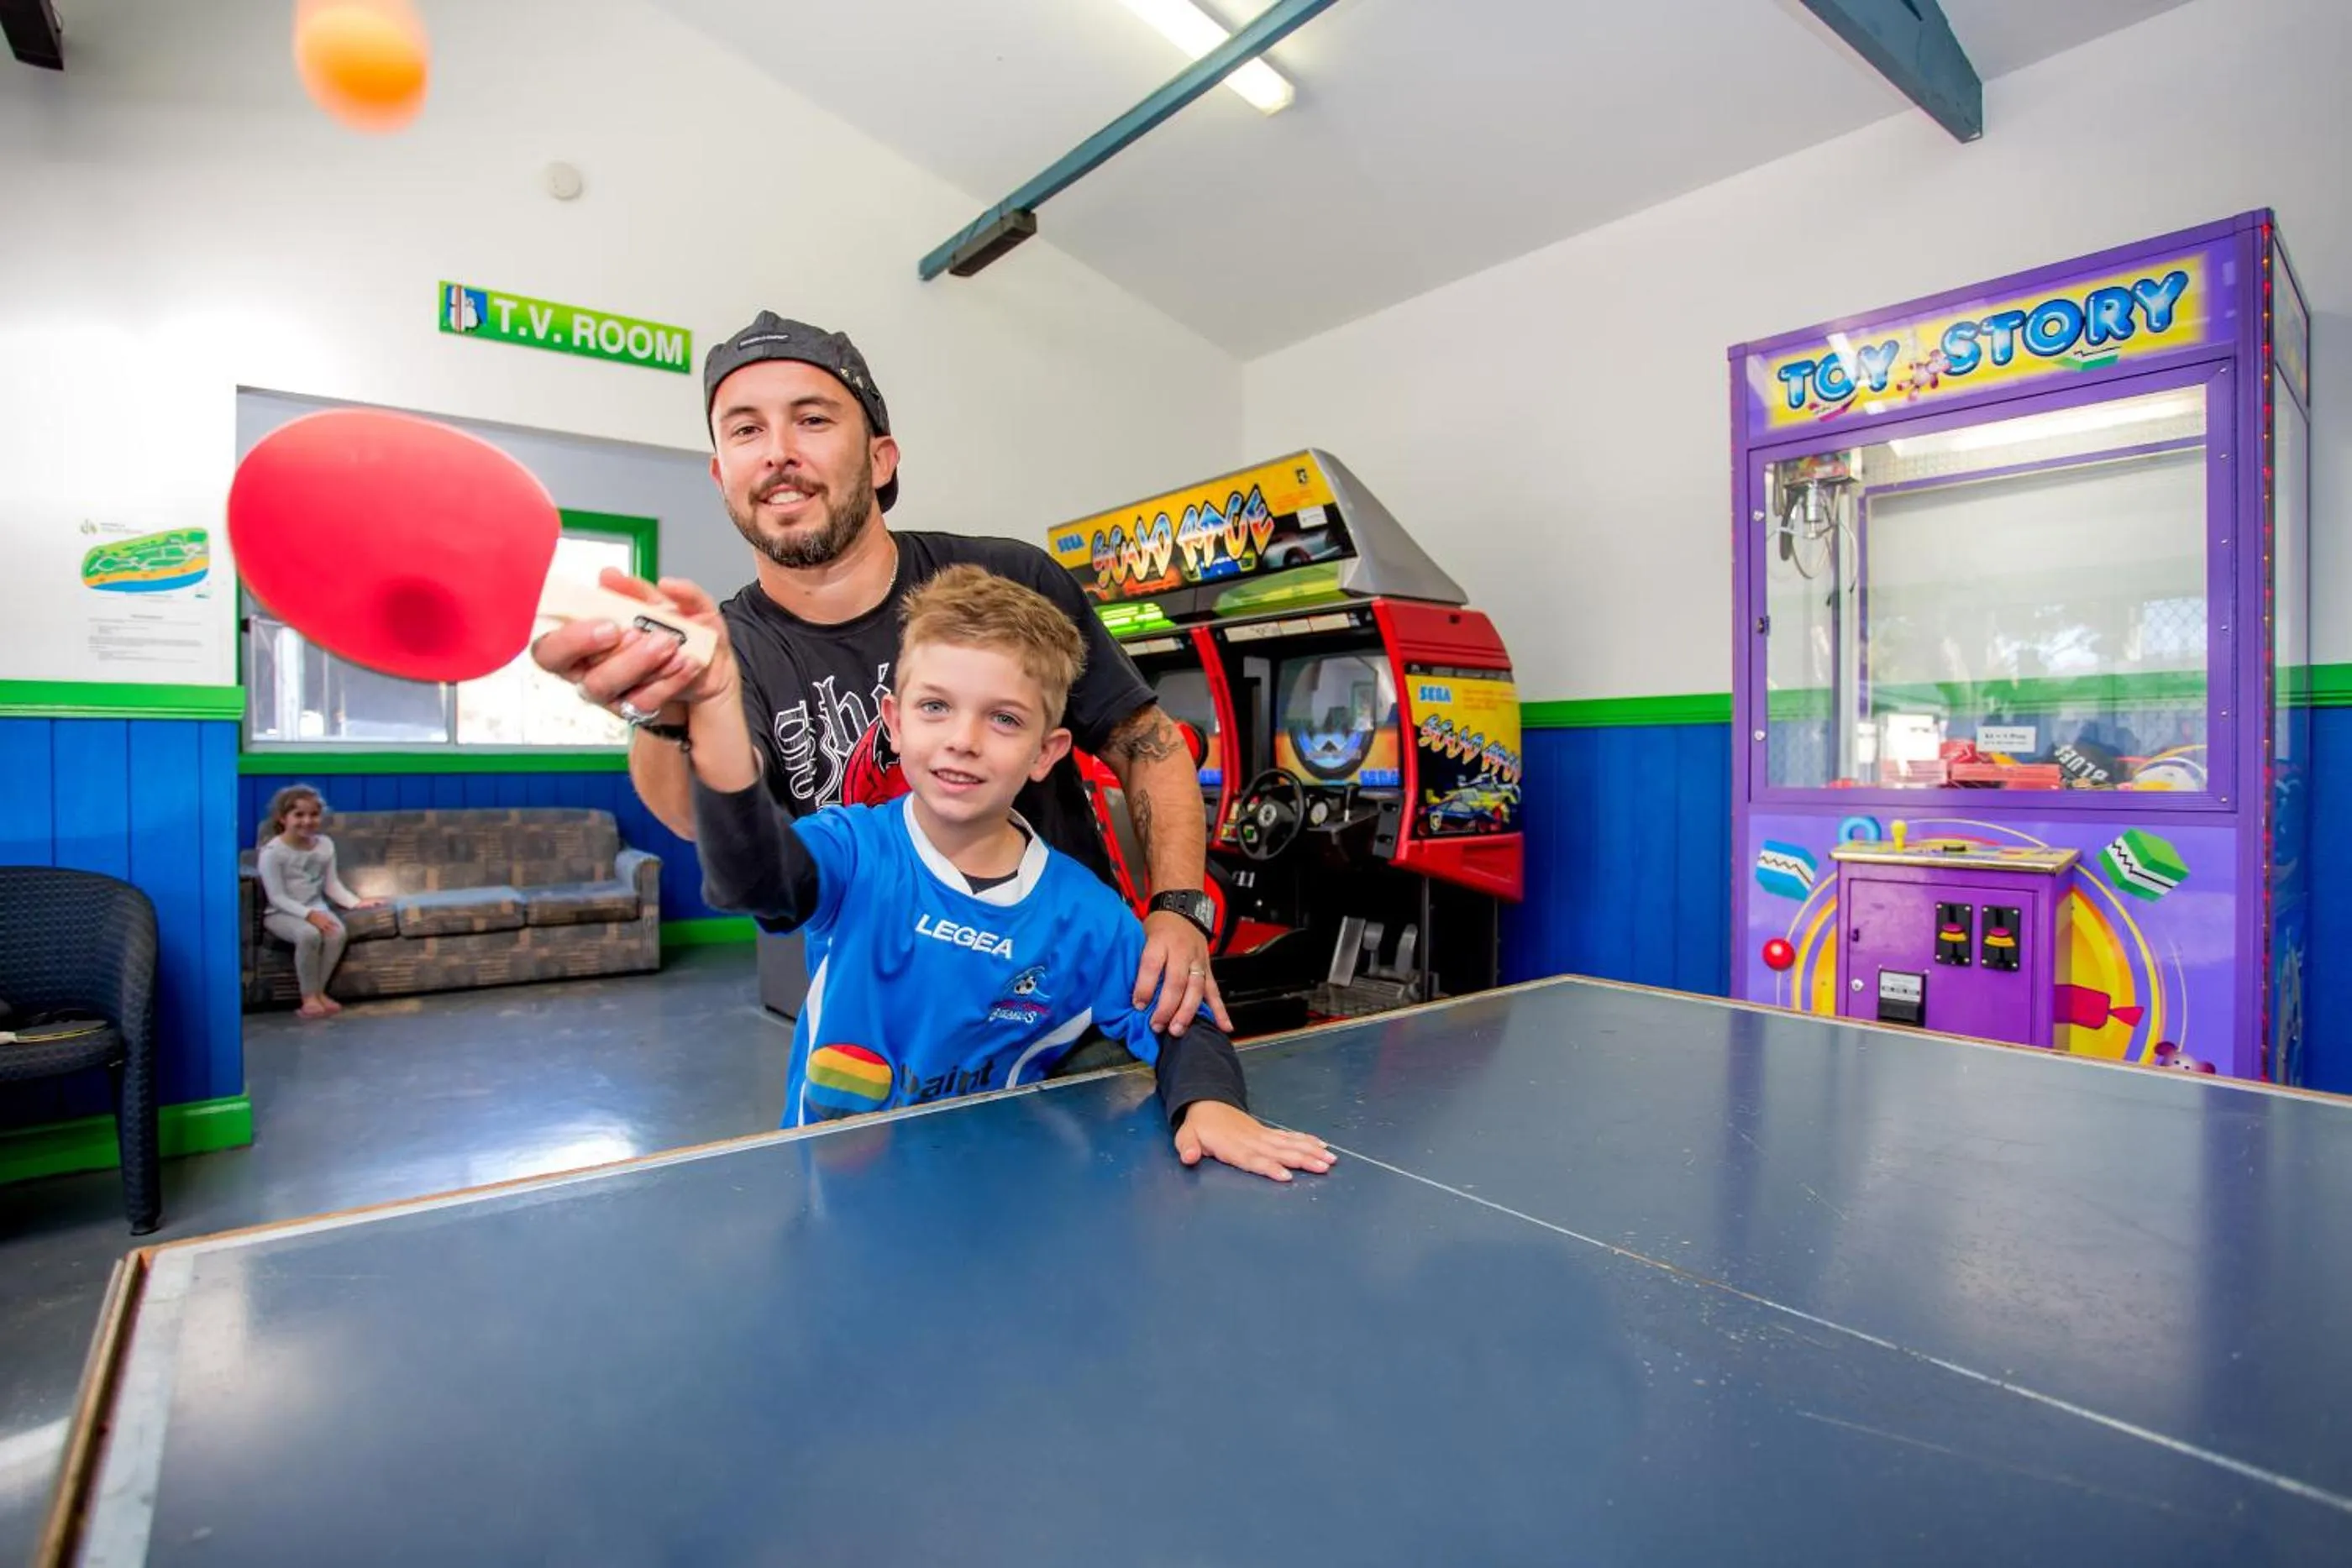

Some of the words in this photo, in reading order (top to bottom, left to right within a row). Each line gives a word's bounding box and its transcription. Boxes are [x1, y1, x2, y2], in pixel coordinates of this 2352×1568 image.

[493, 297, 562, 343] T.V.
[572, 313, 684, 366] ROOM
[1777, 339, 1900, 409] TOY
[1942, 270, 2190, 376] STORY
[1056, 532, 1086, 553] SEGA
[1418, 684, 1452, 704] SEGA
[916, 913, 1014, 959] LEGEA
